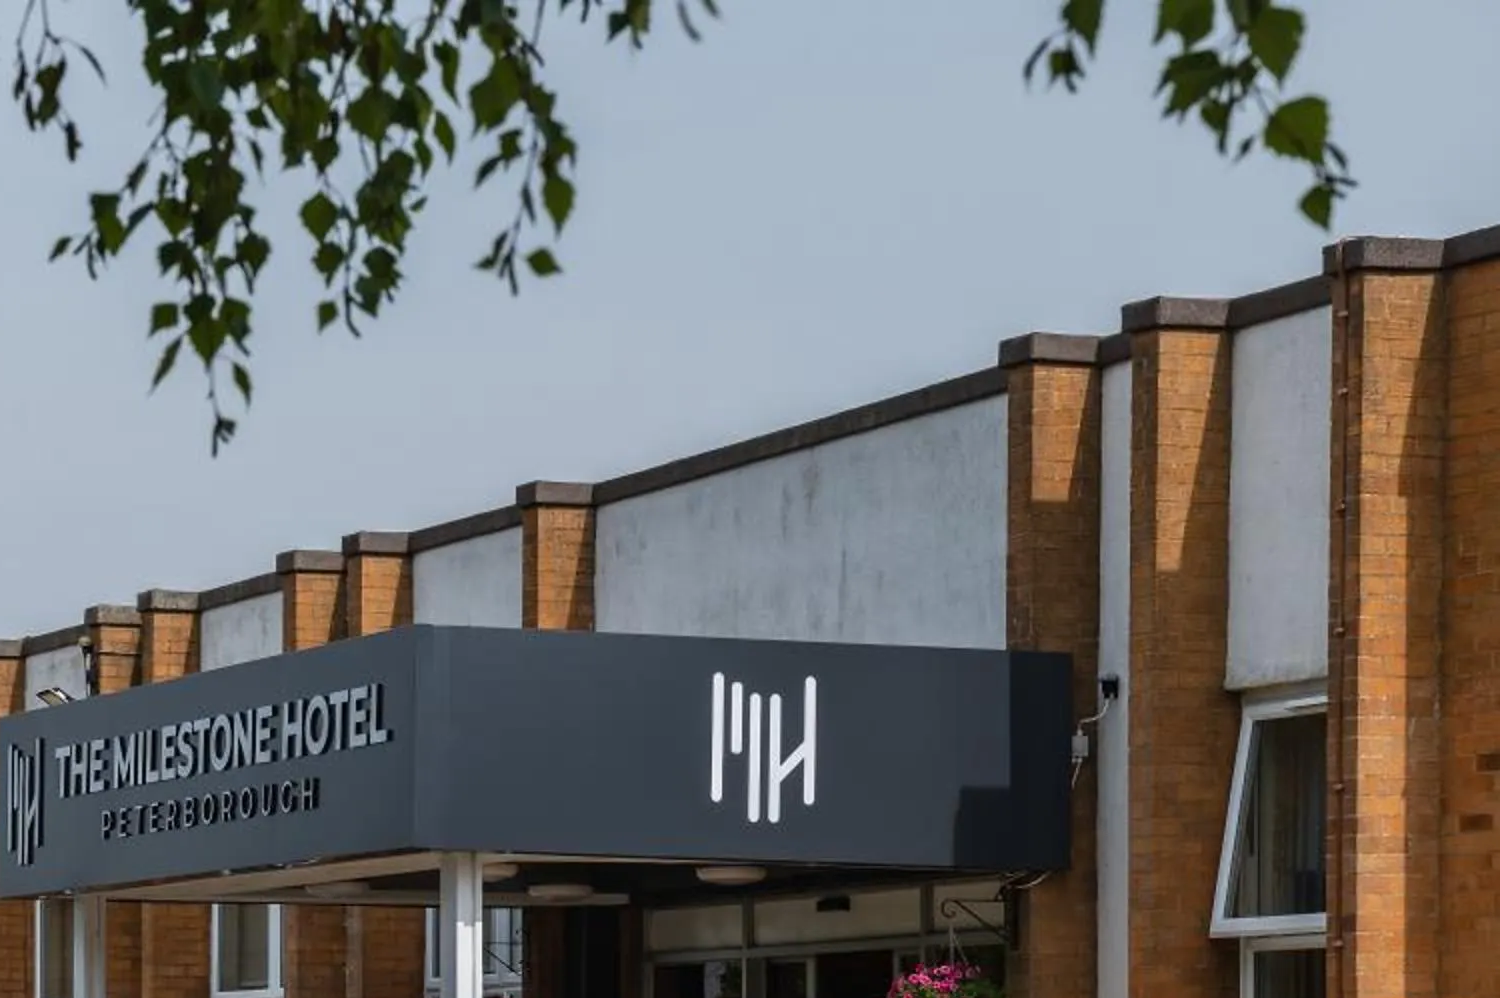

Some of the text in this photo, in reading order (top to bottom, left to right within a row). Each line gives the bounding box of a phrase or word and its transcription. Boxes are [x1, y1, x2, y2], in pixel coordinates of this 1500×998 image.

[55, 683, 390, 798] THE MILESTONE HOTEL
[102, 778, 320, 839] PETERBOROUGH
